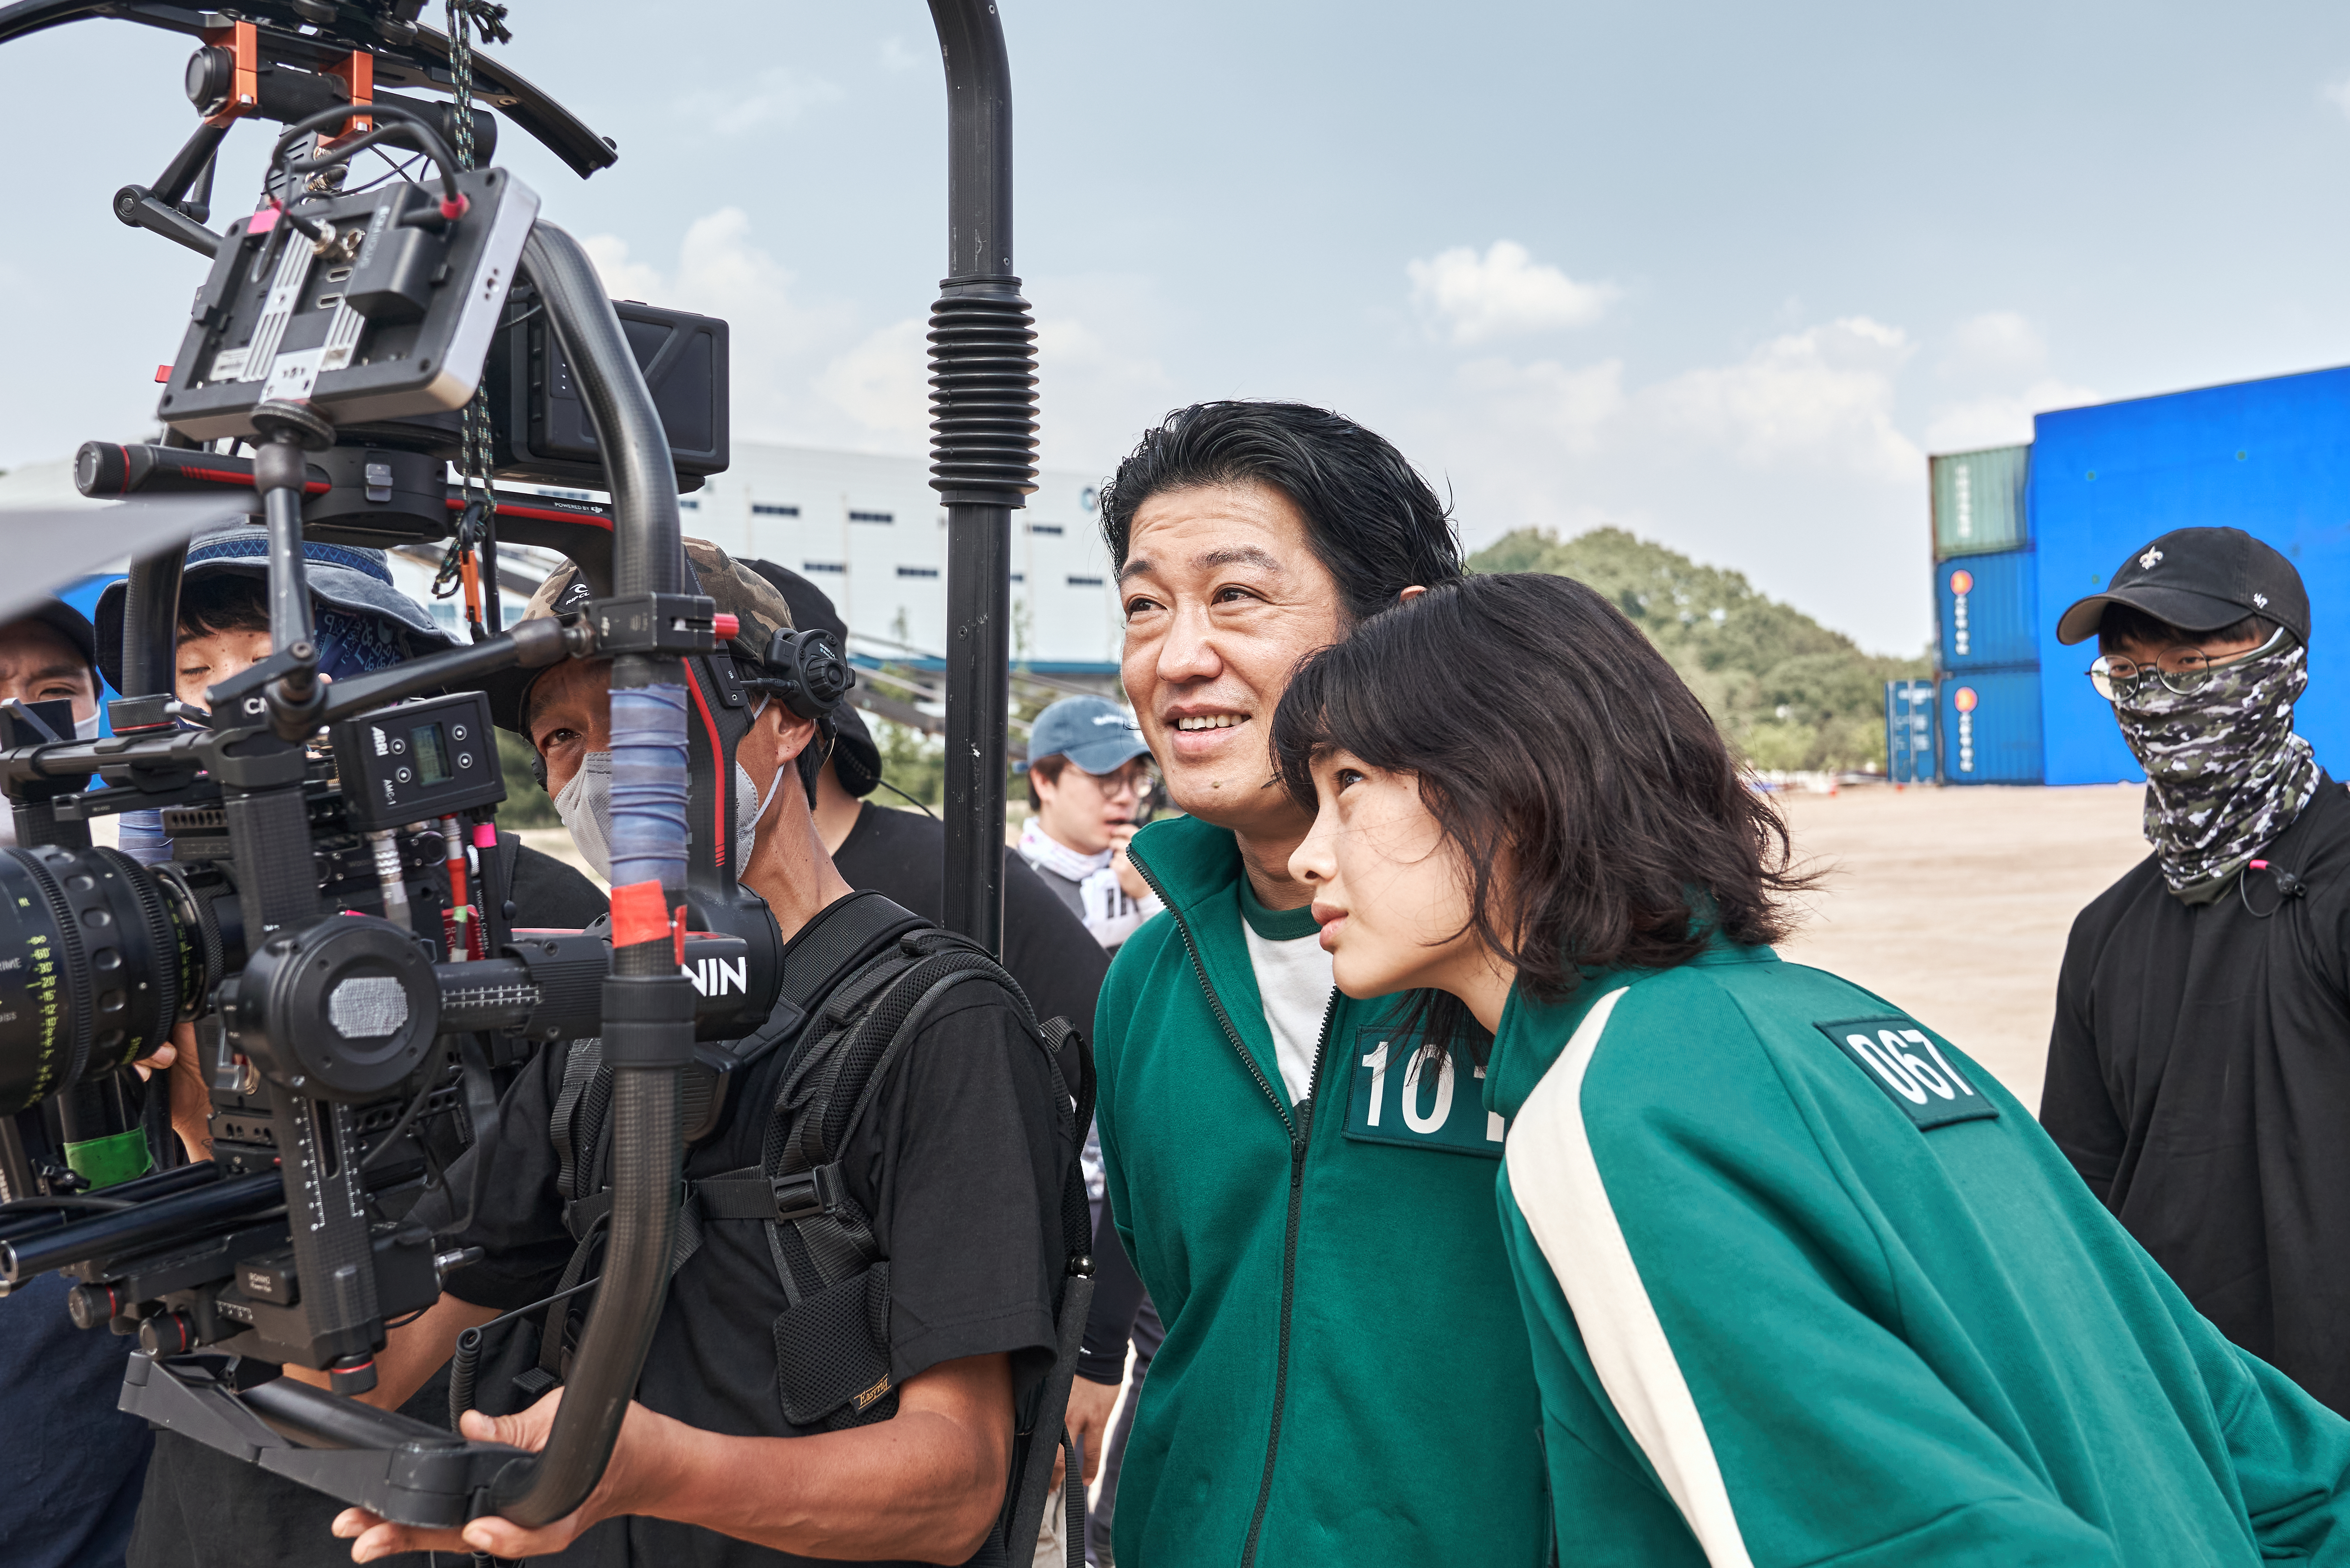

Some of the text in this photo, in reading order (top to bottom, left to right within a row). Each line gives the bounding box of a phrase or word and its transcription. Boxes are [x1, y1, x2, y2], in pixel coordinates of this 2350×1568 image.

[686, 559, 698, 581] ANTENNA
[566, 595, 578, 605] RIP
[819, 643, 836, 659] SENA
[371, 726, 389, 757] ARRI
[477, 889, 485, 920] WOODEN
[682, 956, 747, 996] NIN
[1846, 1030, 1973, 1105] 067
[859, 1377, 888, 1406] Easyrig
